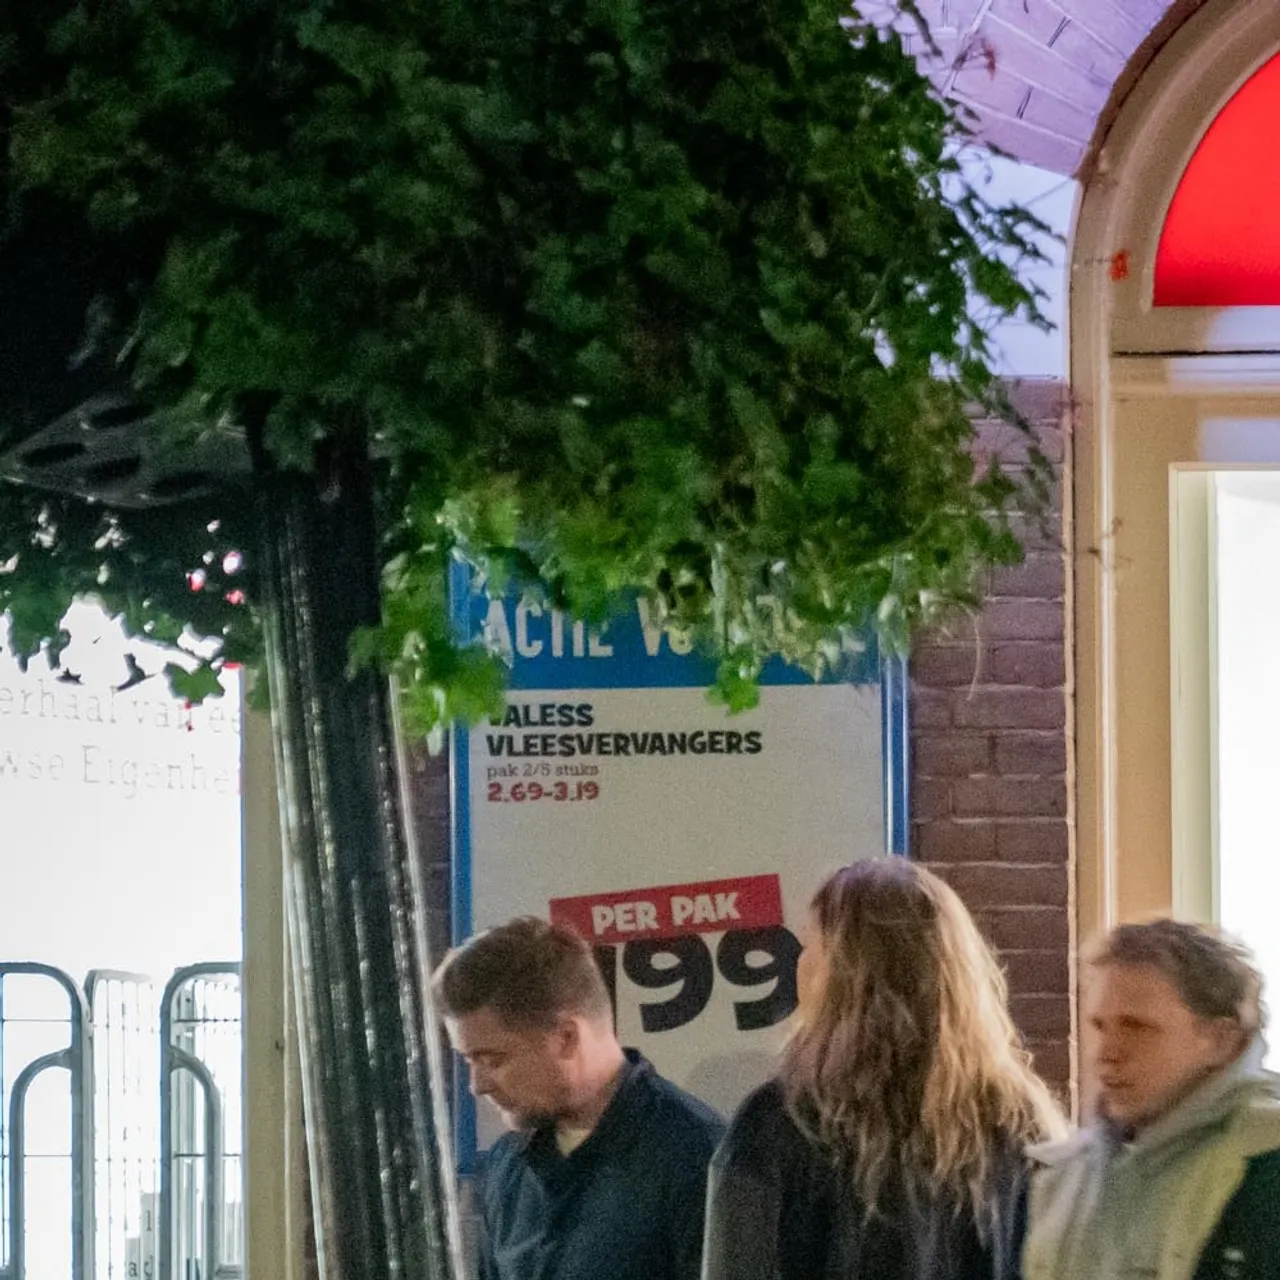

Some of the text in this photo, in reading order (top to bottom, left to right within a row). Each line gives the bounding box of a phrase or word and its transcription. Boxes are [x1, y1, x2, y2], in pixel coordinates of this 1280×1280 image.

[488, 703, 594, 728] ALESS
[486, 730, 763, 757] VLEESVERVANGERS
[487, 763, 519, 781] pak
[555, 762, 600, 777] stuks
[591, 892, 741, 936] PER PAK
